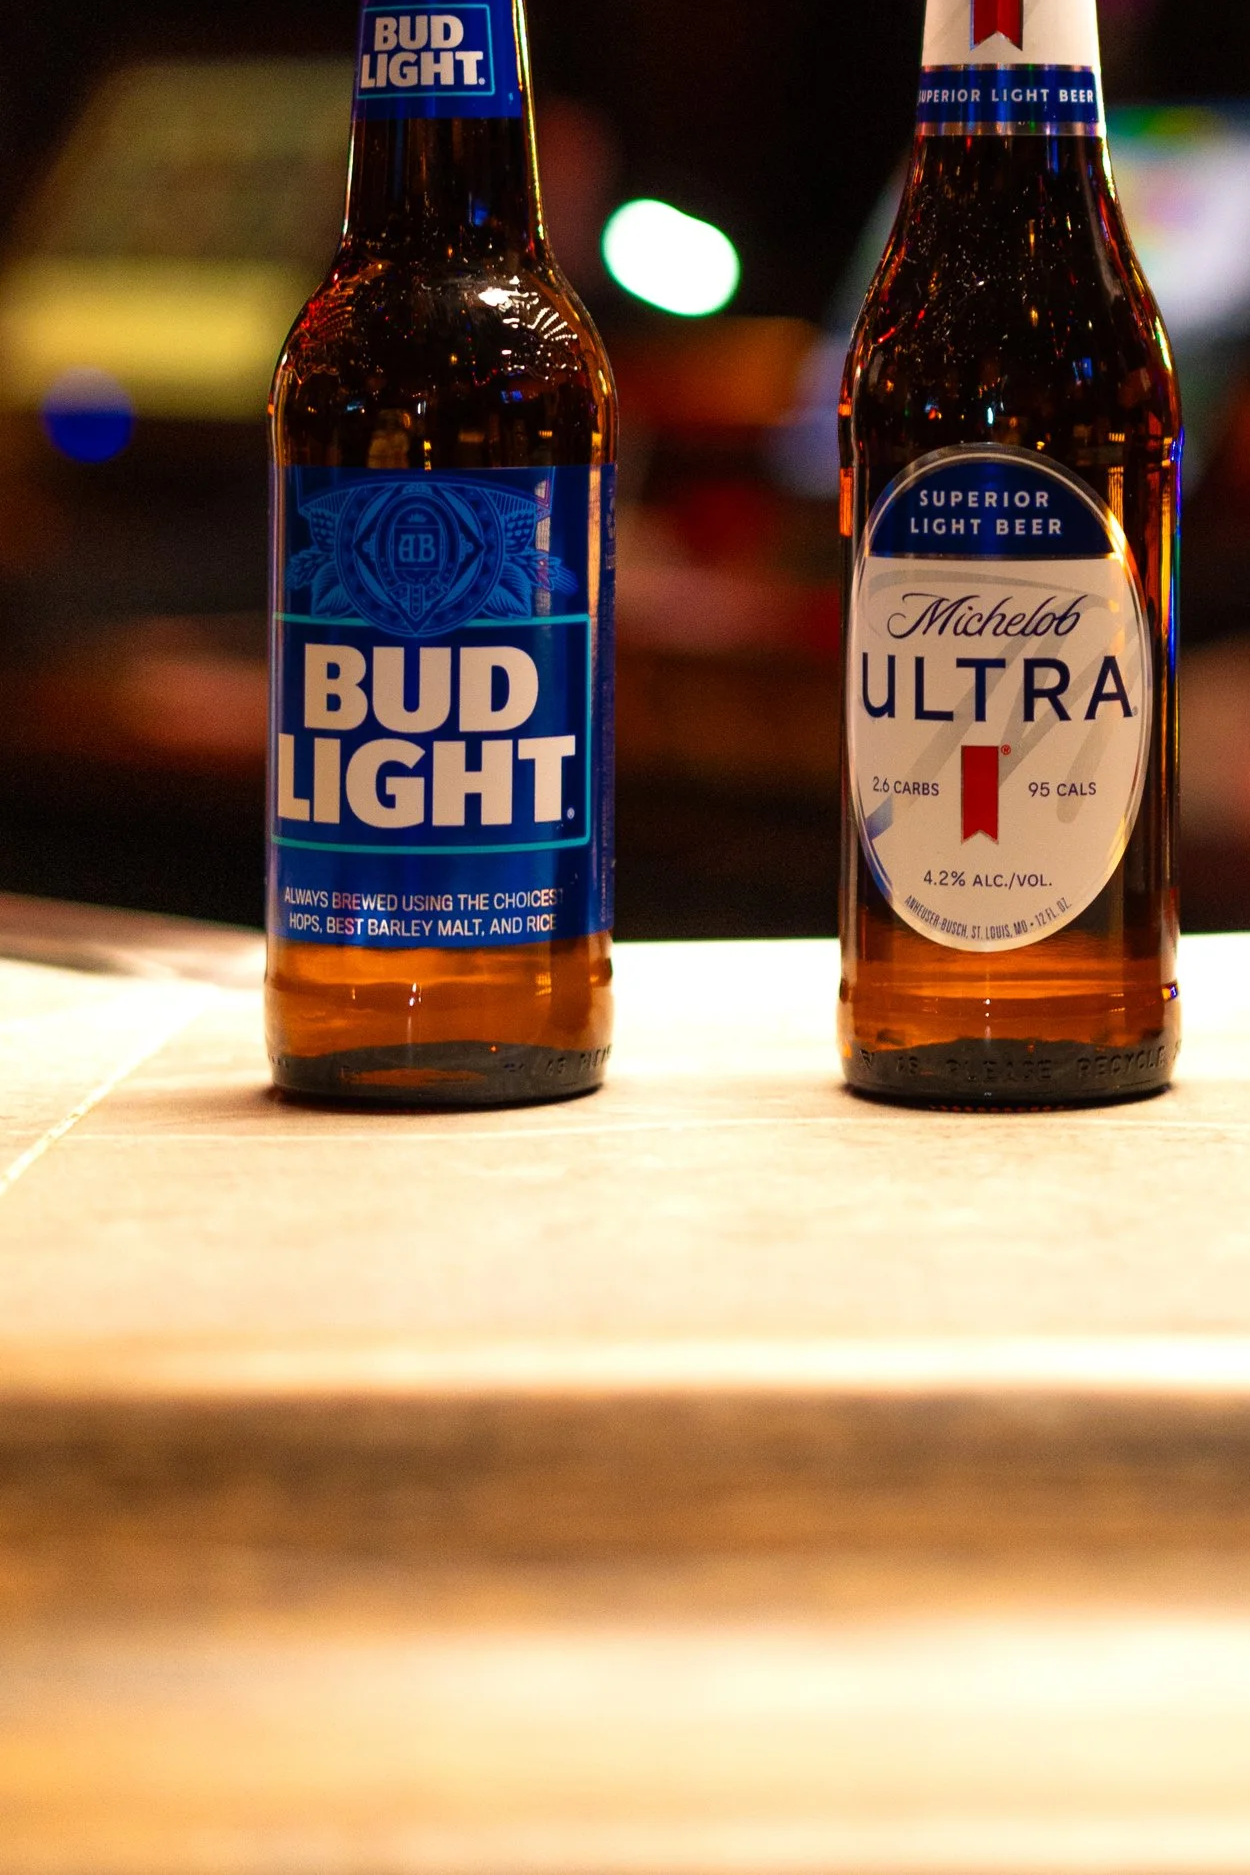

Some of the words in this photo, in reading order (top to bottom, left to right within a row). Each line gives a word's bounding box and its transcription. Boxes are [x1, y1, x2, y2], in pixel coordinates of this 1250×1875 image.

[374, 15, 464, 51] BUD
[361, 51, 484, 89] LIGHT
[917, 89, 981, 103] SUPERIOR
[991, 88, 1050, 102] LIGHT
[1058, 89, 1094, 103] BEER
[919, 489, 1050, 508] SUPERIOR
[910, 517, 982, 535] LIGHT
[995, 519, 1063, 535] BEER
[887, 592, 1088, 639] Michelob
[304, 643, 539, 733] BUD
[862, 652, 1134, 723] ULTRA
[278, 734, 576, 829] LIGHT
[872, 776, 890, 793] 2.6
[893, 780, 940, 796] CARBS
[1028, 781, 1050, 797] 95
[1056, 781, 1097, 796] CALS
[923, 870, 966, 887] 4.2%
[972, 873, 1053, 890] ALC./VOL.
[284, 886, 329, 908] ALWAYS
[332, 891, 398, 911] BREWED
[402, 894, 453, 912] USING
[457, 893, 490, 911] THE
[289, 913, 323, 934] HOPS,
[326, 918, 364, 936] BEST
[367, 919, 433, 937] BARLEY
[437, 919, 485, 937] MALT,
[489, 917, 523, 934] AND
[526, 913, 557, 932] RICE
[904, 894, 969, 940] ANHEUSER-BUSCH,
[971, 926, 984, 941] ST.
[985, 924, 1013, 940] LOUIS,
[1013, 921, 1029, 936] MO
[1034, 913, 1047, 927] 12
[1046, 907, 1060, 922] FL.
[1056, 897, 1073, 914] OZ.
